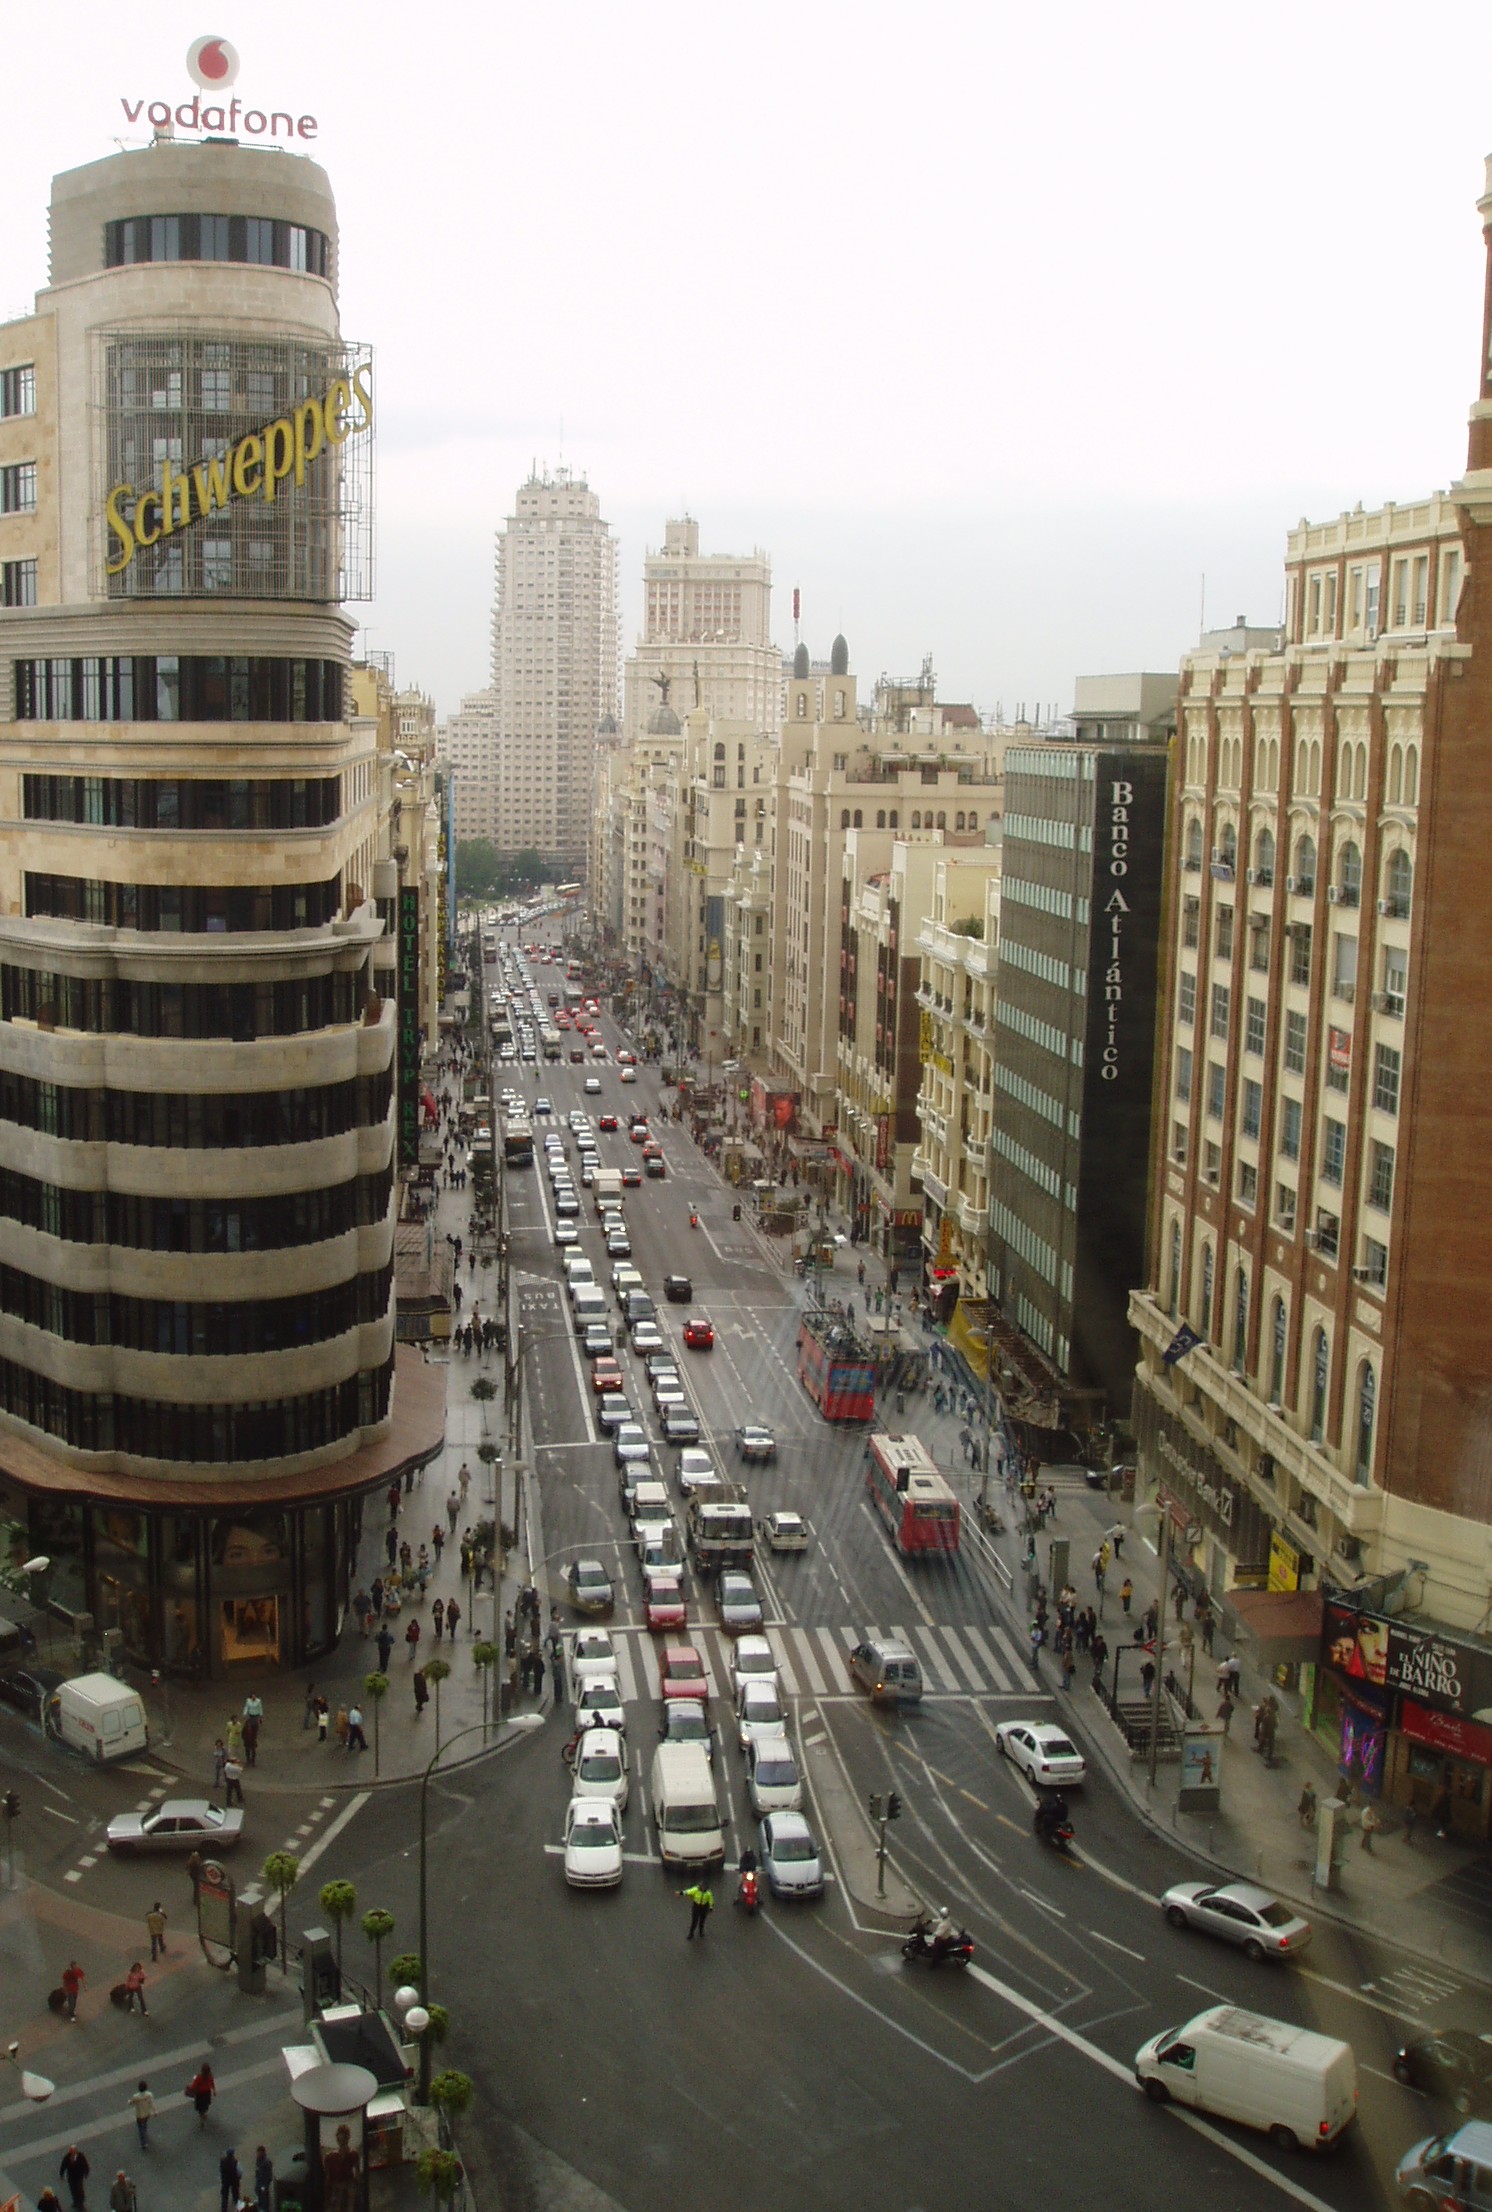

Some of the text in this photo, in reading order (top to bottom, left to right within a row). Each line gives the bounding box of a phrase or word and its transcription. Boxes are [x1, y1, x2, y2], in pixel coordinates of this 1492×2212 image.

[121, 95, 318, 140] vodafone
[105, 363, 372, 574] Schweppes
[1101, 781, 1134, 1080] Banco Atlántico
[403, 894, 416, 1157] HOTEL TRYP REX
[1401, 1661, 1462, 1698] BARRO
[1411, 1649, 1457, 1678] NIÑO
